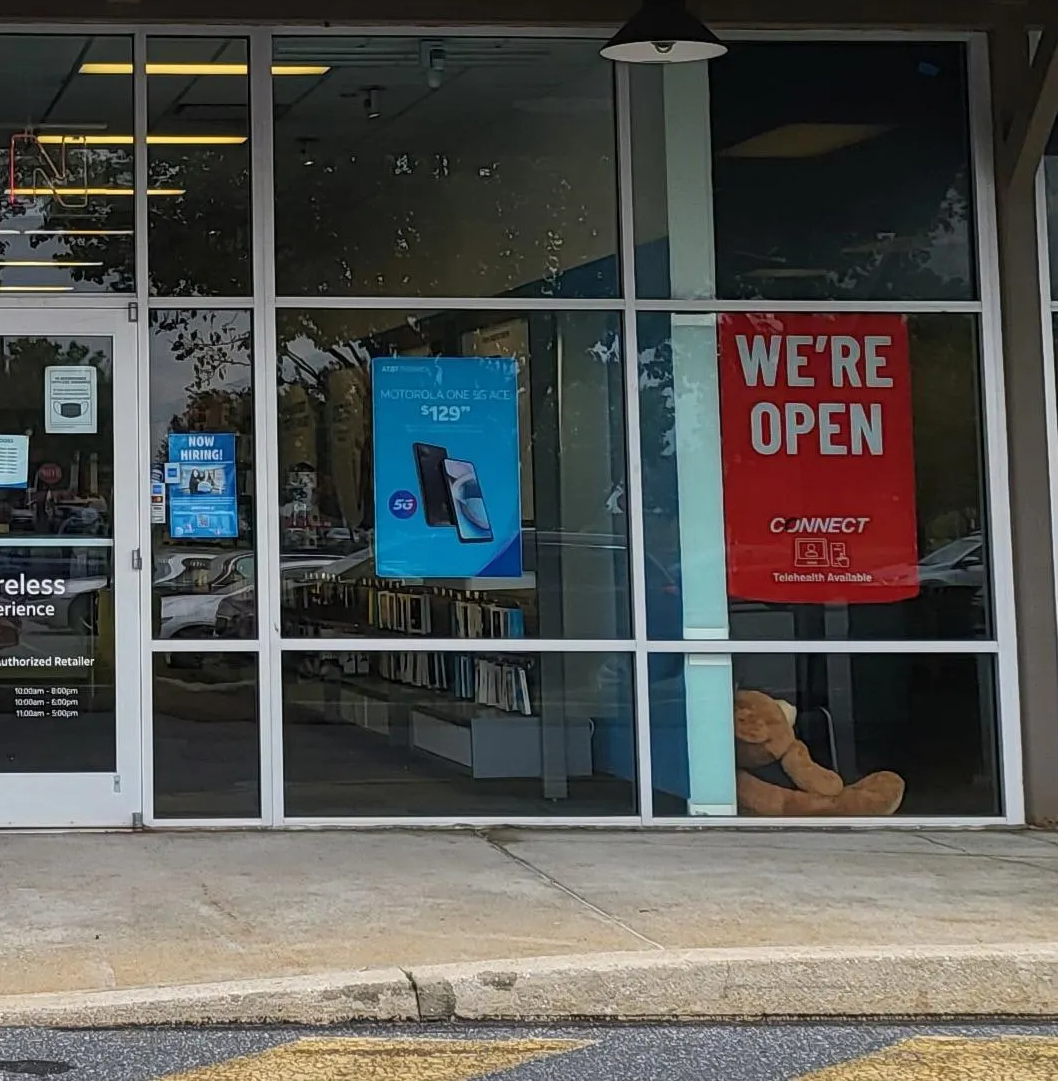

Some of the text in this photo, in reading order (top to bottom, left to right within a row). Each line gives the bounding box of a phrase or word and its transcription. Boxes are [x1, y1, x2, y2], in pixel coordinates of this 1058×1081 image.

[735, 334, 894, 387] WE'RE
[380, 389, 444, 400] MOTOROLA
[446, 389, 471, 400] ONE
[489, 390, 511, 400] ACE
[750, 402, 884, 456] OPEN
[188, 435, 215, 447] NOW
[180, 449, 223, 461] HIRING!
[392, 498, 414, 511] 5G
[770, 517, 870, 533] CONNECT
[773, 572, 873, 583] Telehealth Available
[54, 656, 95, 667] Retailer
